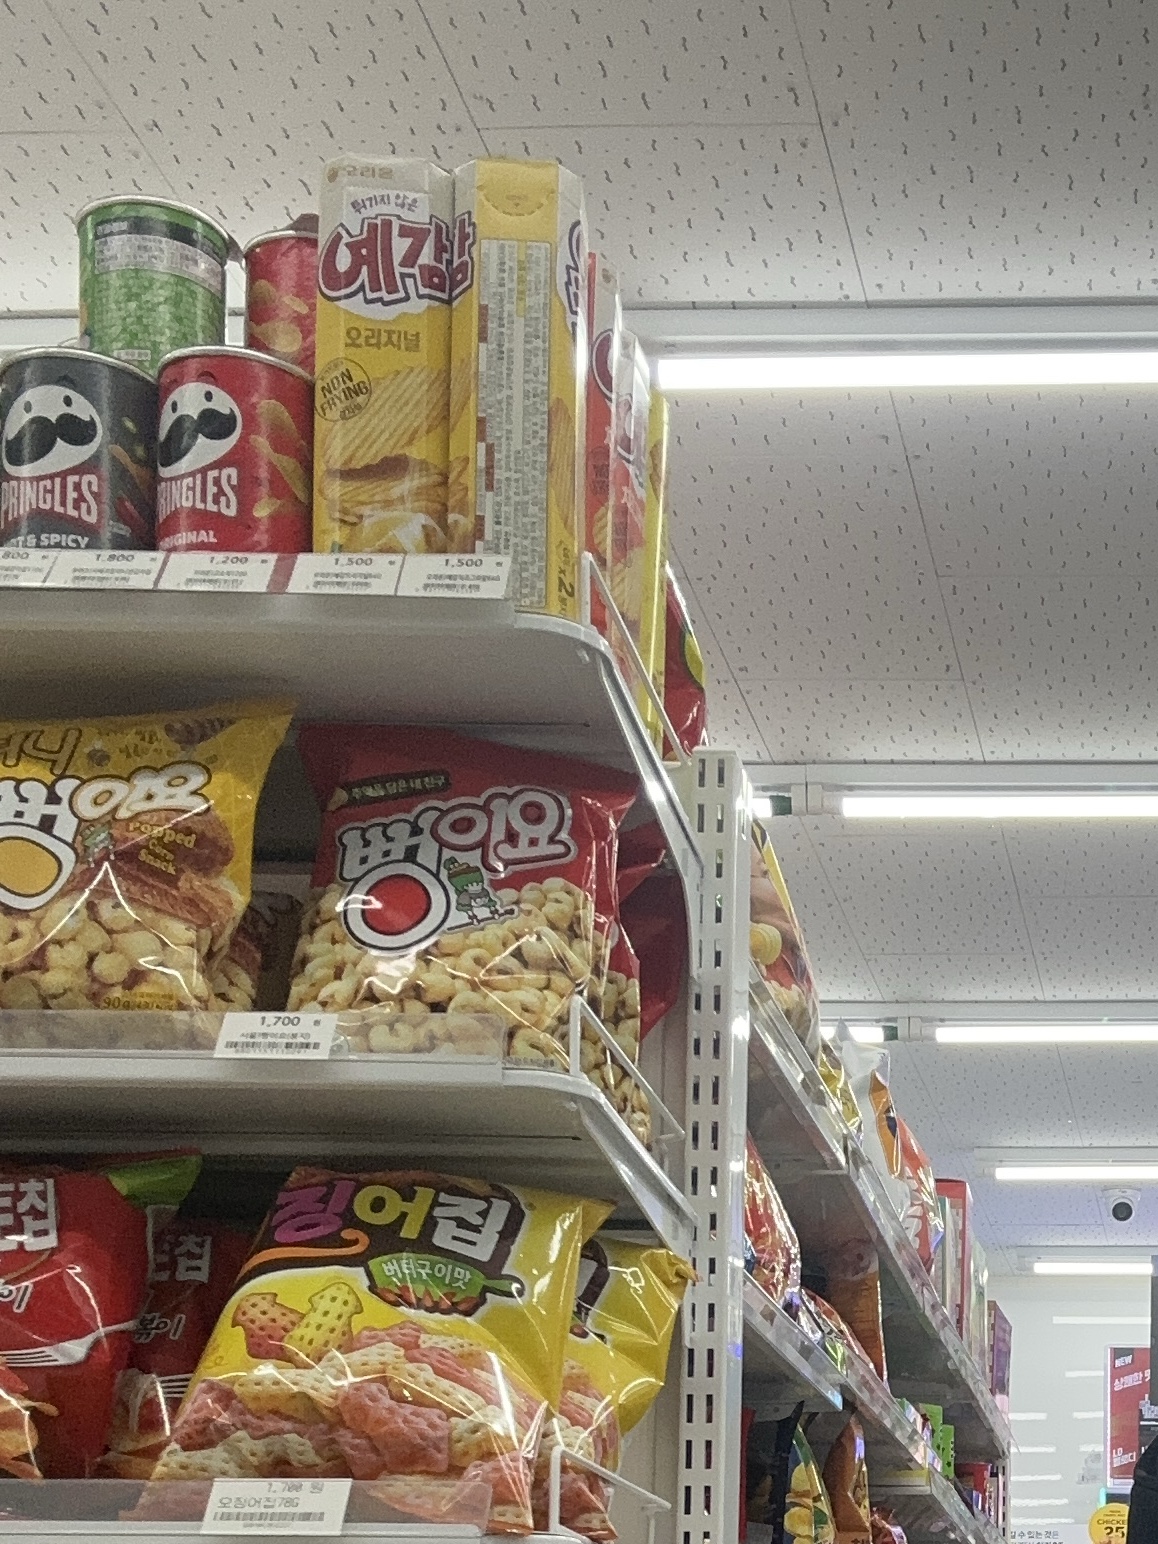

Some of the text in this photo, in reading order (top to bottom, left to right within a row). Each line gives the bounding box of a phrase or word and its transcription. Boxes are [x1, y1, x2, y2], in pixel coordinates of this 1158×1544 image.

[320, 213, 451, 300] 예감
[345, 326, 421, 351] 오리지널
[320, 367, 354, 400] NON
[40, 533, 90, 549] SPICY
[444, 557, 483, 568] 1,500
[129, 821, 197, 849] Popped
[338, 787, 571, 951] 뻥이요
[260, 1016, 301, 1027] 1,700
[382, 1258, 472, 1290] 버터구이맛
[1115, 1354, 1133, 1368] NEW
[217, 1497, 300, 1509] 오징어집78G
[1018, 1530, 1027, 1540] 수
[1027, 1530, 1043, 1540] 있는
[1044, 1530, 1060, 1540] 것은
[1103, 1526, 1126, 1539] 25
